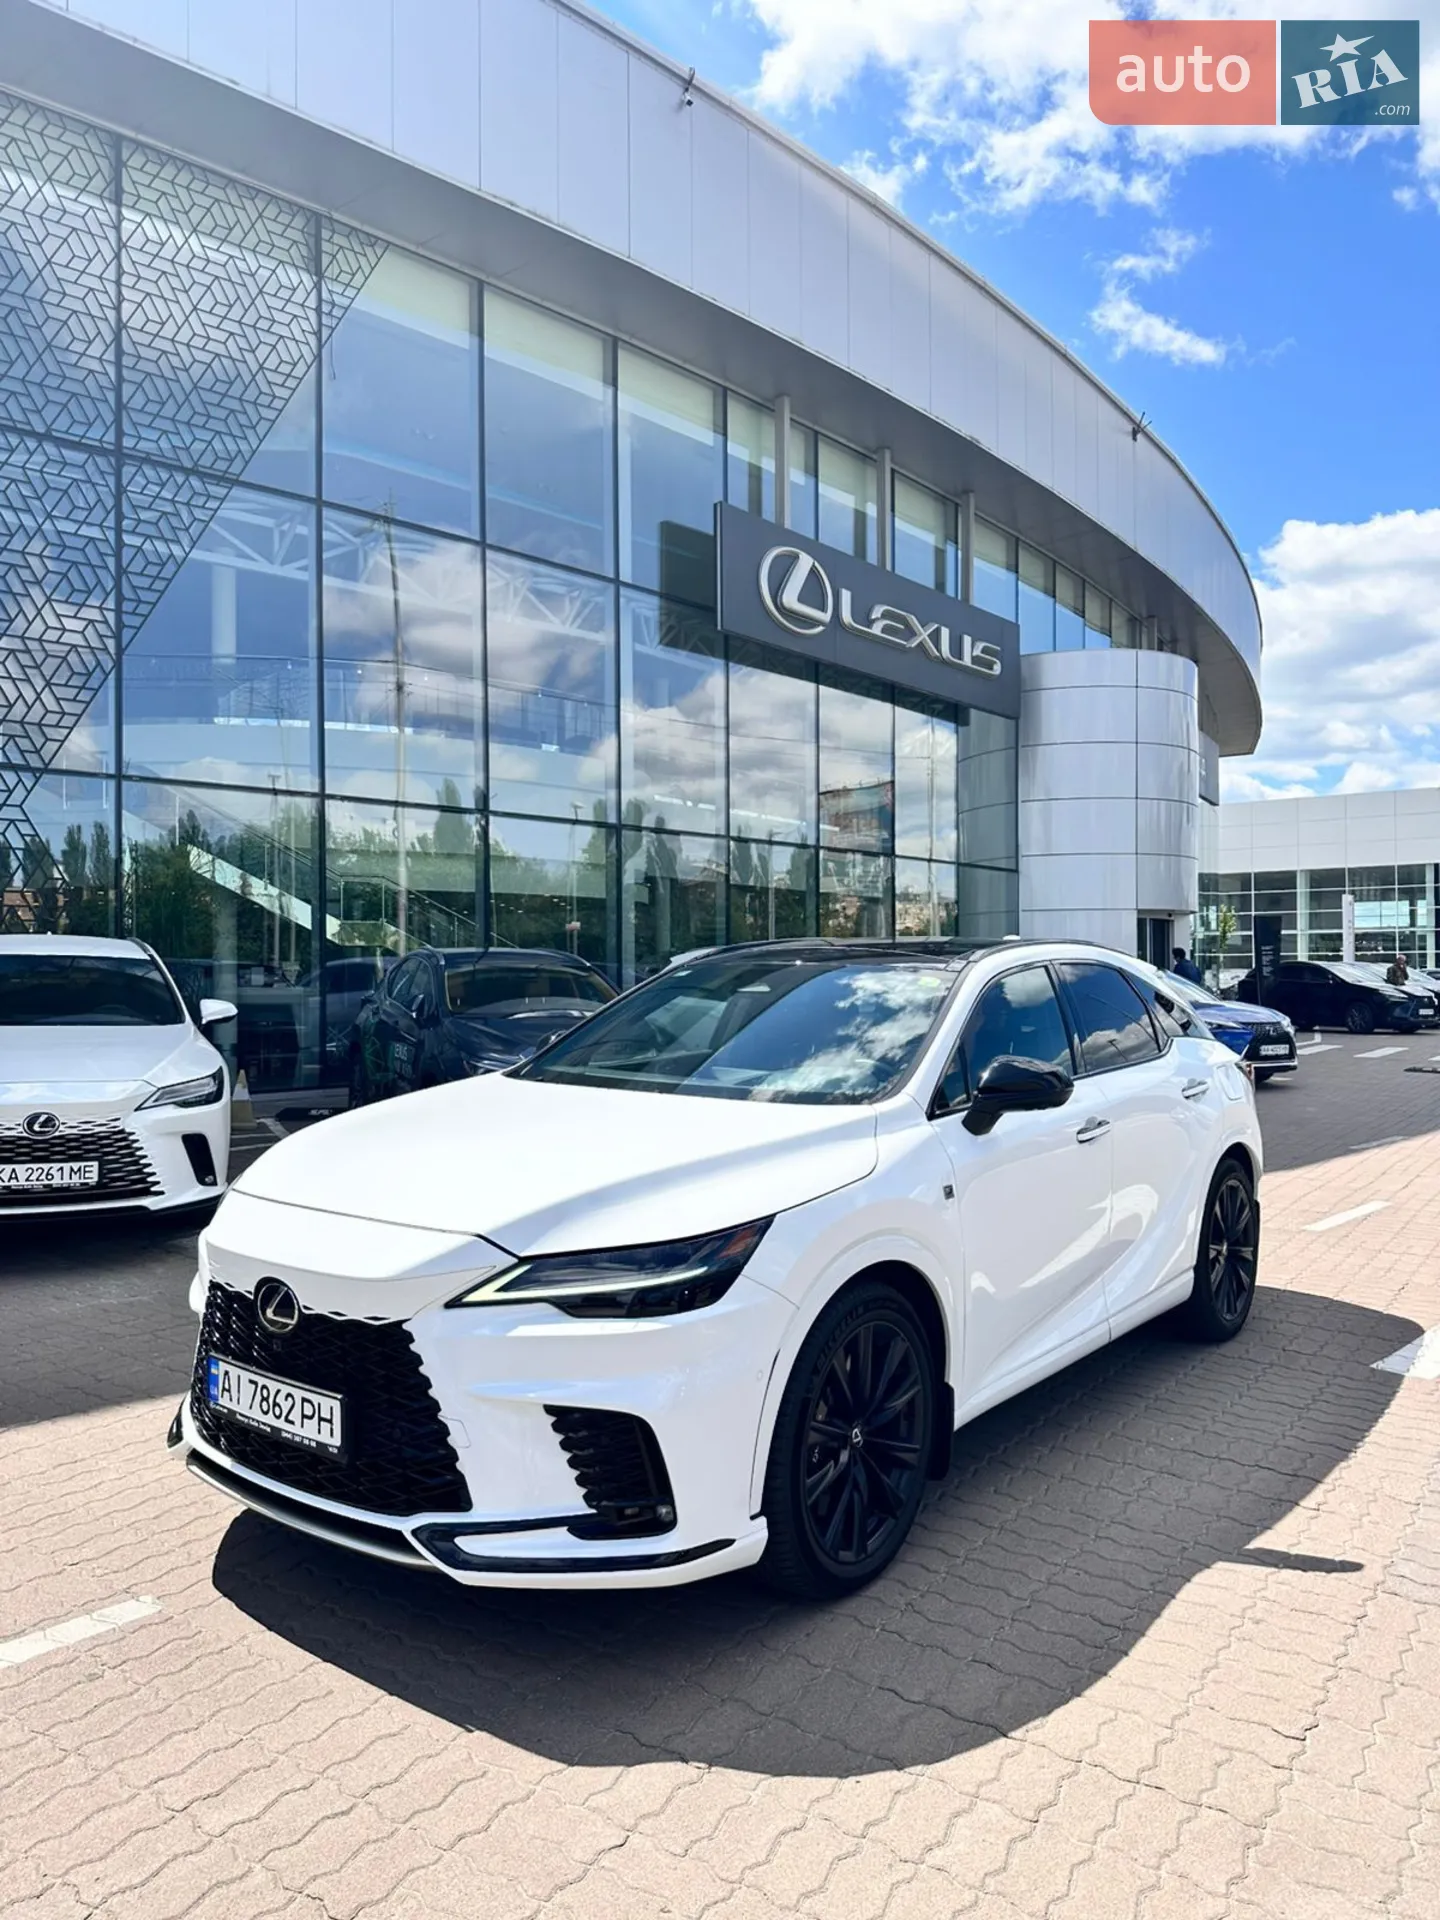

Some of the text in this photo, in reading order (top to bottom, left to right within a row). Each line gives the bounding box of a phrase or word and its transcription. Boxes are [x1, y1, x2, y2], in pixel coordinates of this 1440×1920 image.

[838, 588, 1002, 679] LEXUS
[24, 1166, 64, 1182] 2261
[69, 1164, 94, 1181] ME
[220, 1369, 241, 1406] AI
[248, 1379, 296, 1426] 7862
[300, 1396, 334, 1439] PH
